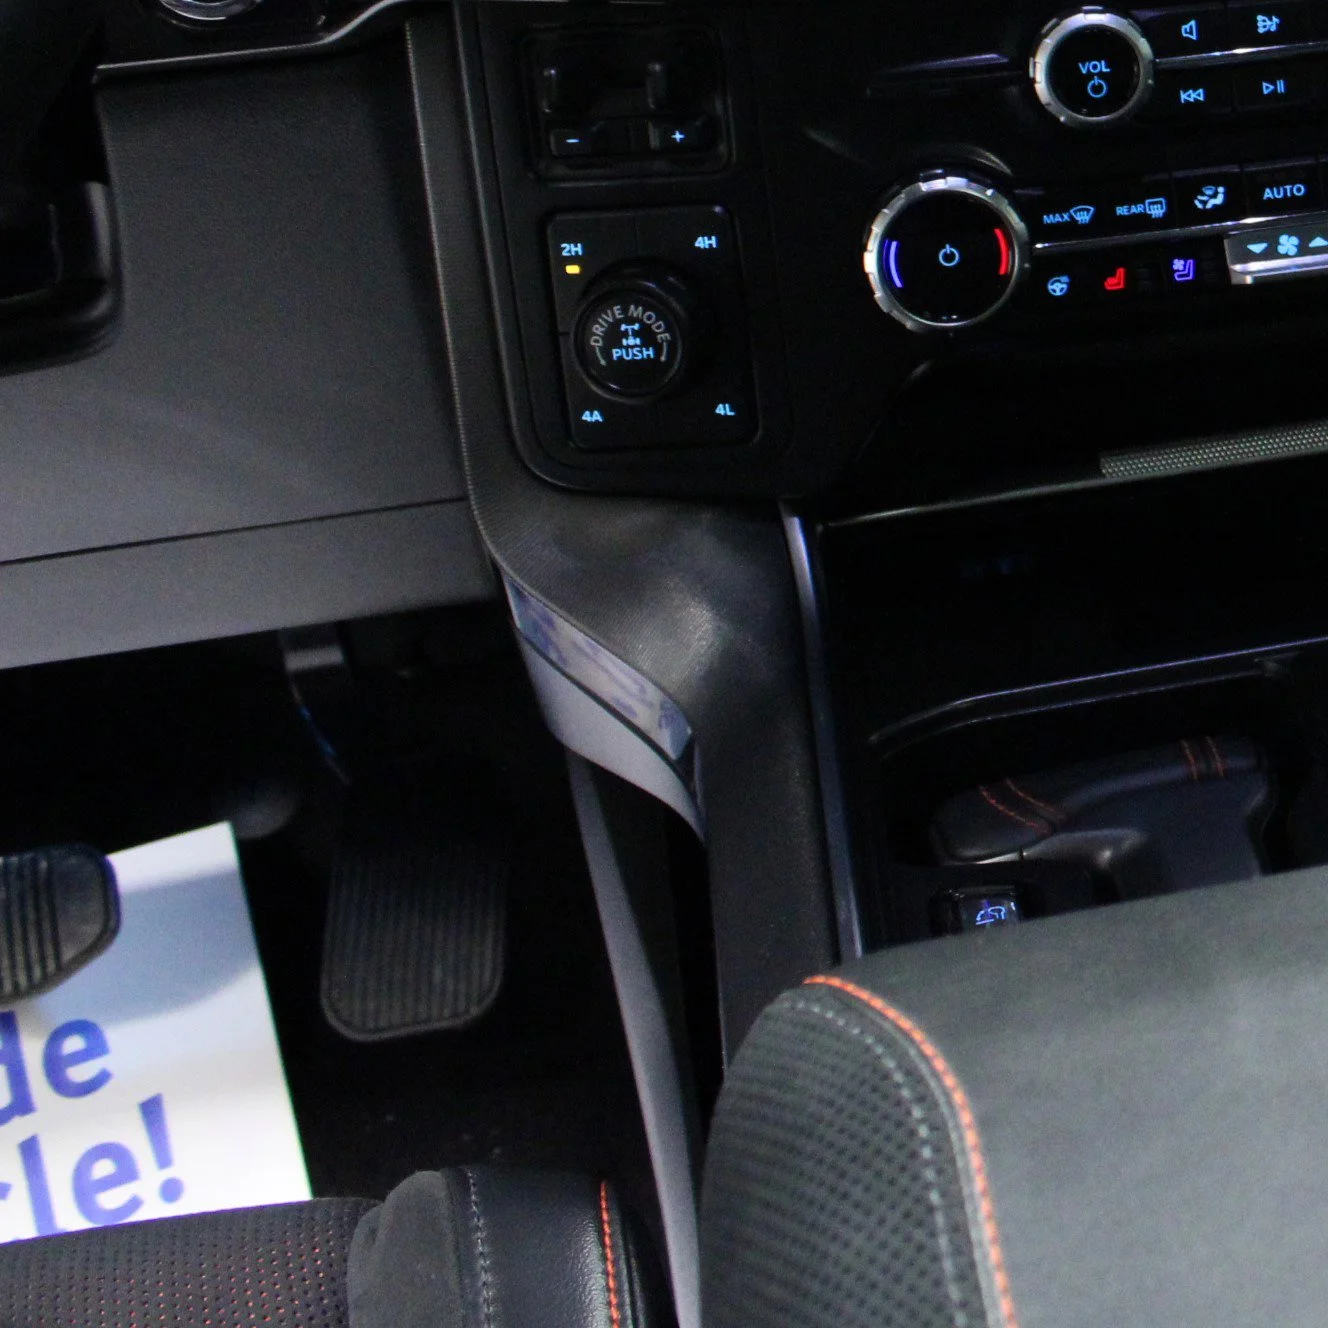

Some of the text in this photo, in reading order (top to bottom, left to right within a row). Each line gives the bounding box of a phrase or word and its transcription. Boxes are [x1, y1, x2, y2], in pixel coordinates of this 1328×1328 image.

[1078, 60, 1110, 74] VOL
[1262, 183, 1306, 200] AUTO
[1116, 203, 1144, 217] REAR
[1043, 213, 1071, 226] MAX
[560, 242, 583, 257] 2H
[694, 235, 718, 250] 4H
[590, 304, 672, 347] DRIVE MODE
[612, 347, 655, 361] PUSH
[581, 409, 603, 423] 4A
[715, 403, 736, 416] 4L
[0, 1093, 185, 1236] le!
